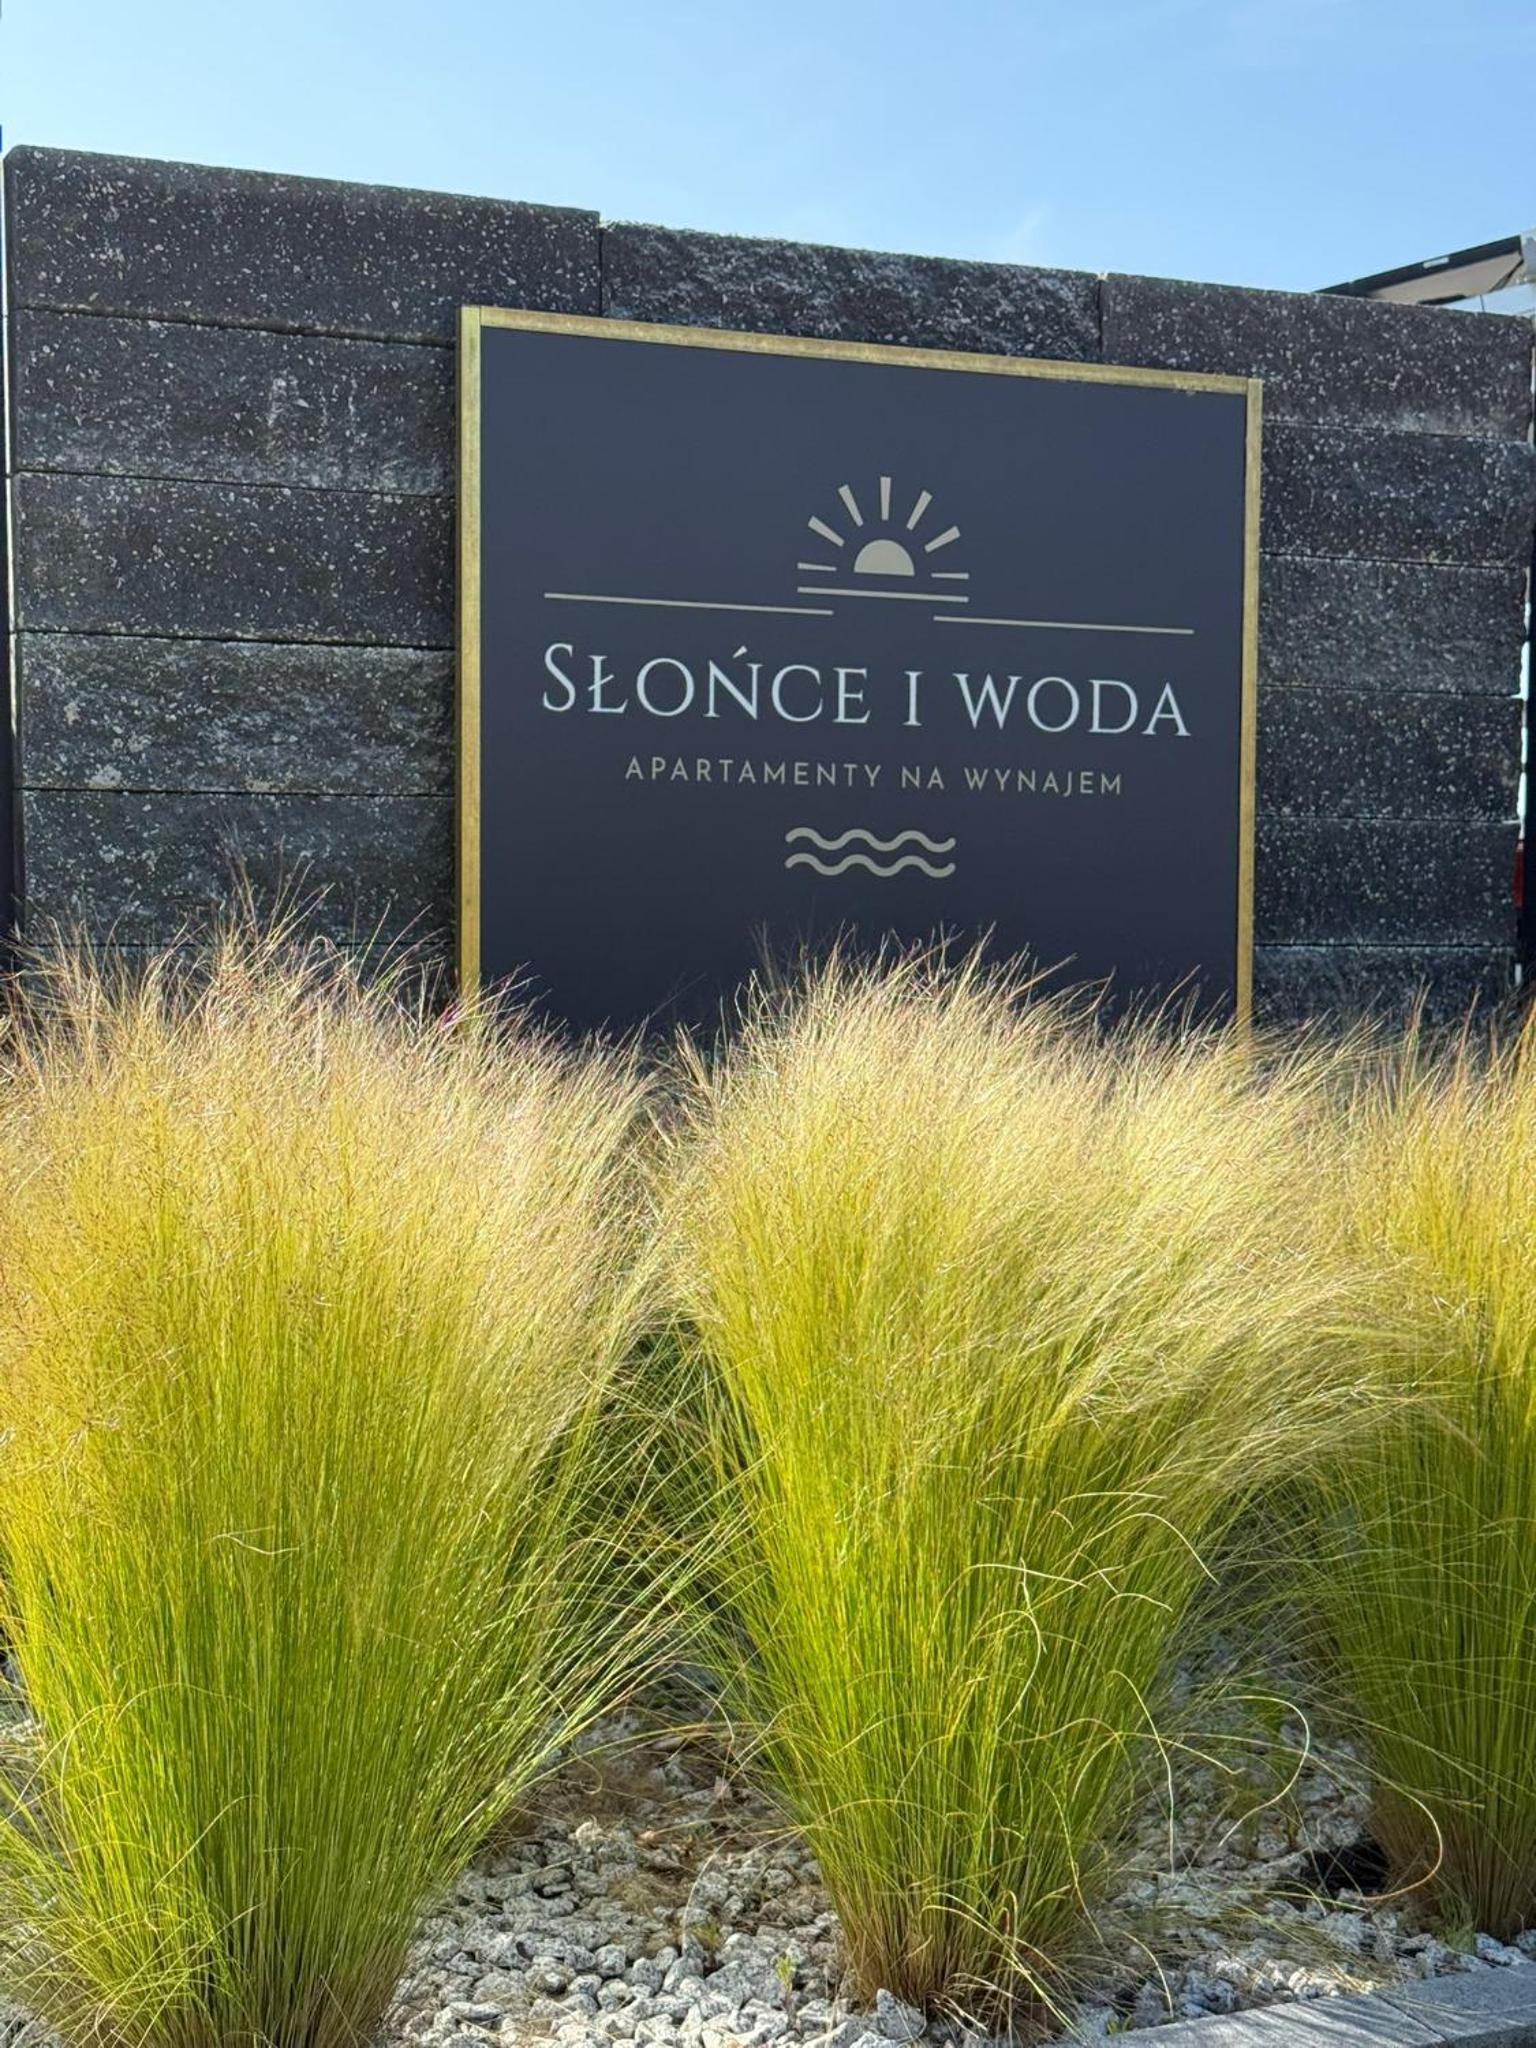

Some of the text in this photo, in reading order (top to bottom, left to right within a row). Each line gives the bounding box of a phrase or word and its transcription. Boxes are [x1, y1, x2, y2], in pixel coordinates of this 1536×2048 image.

[542, 642, 1191, 737] SŁOŃCE I WODA
[625, 756, 1123, 797] APARTAMENTY NA WYNAJEM
